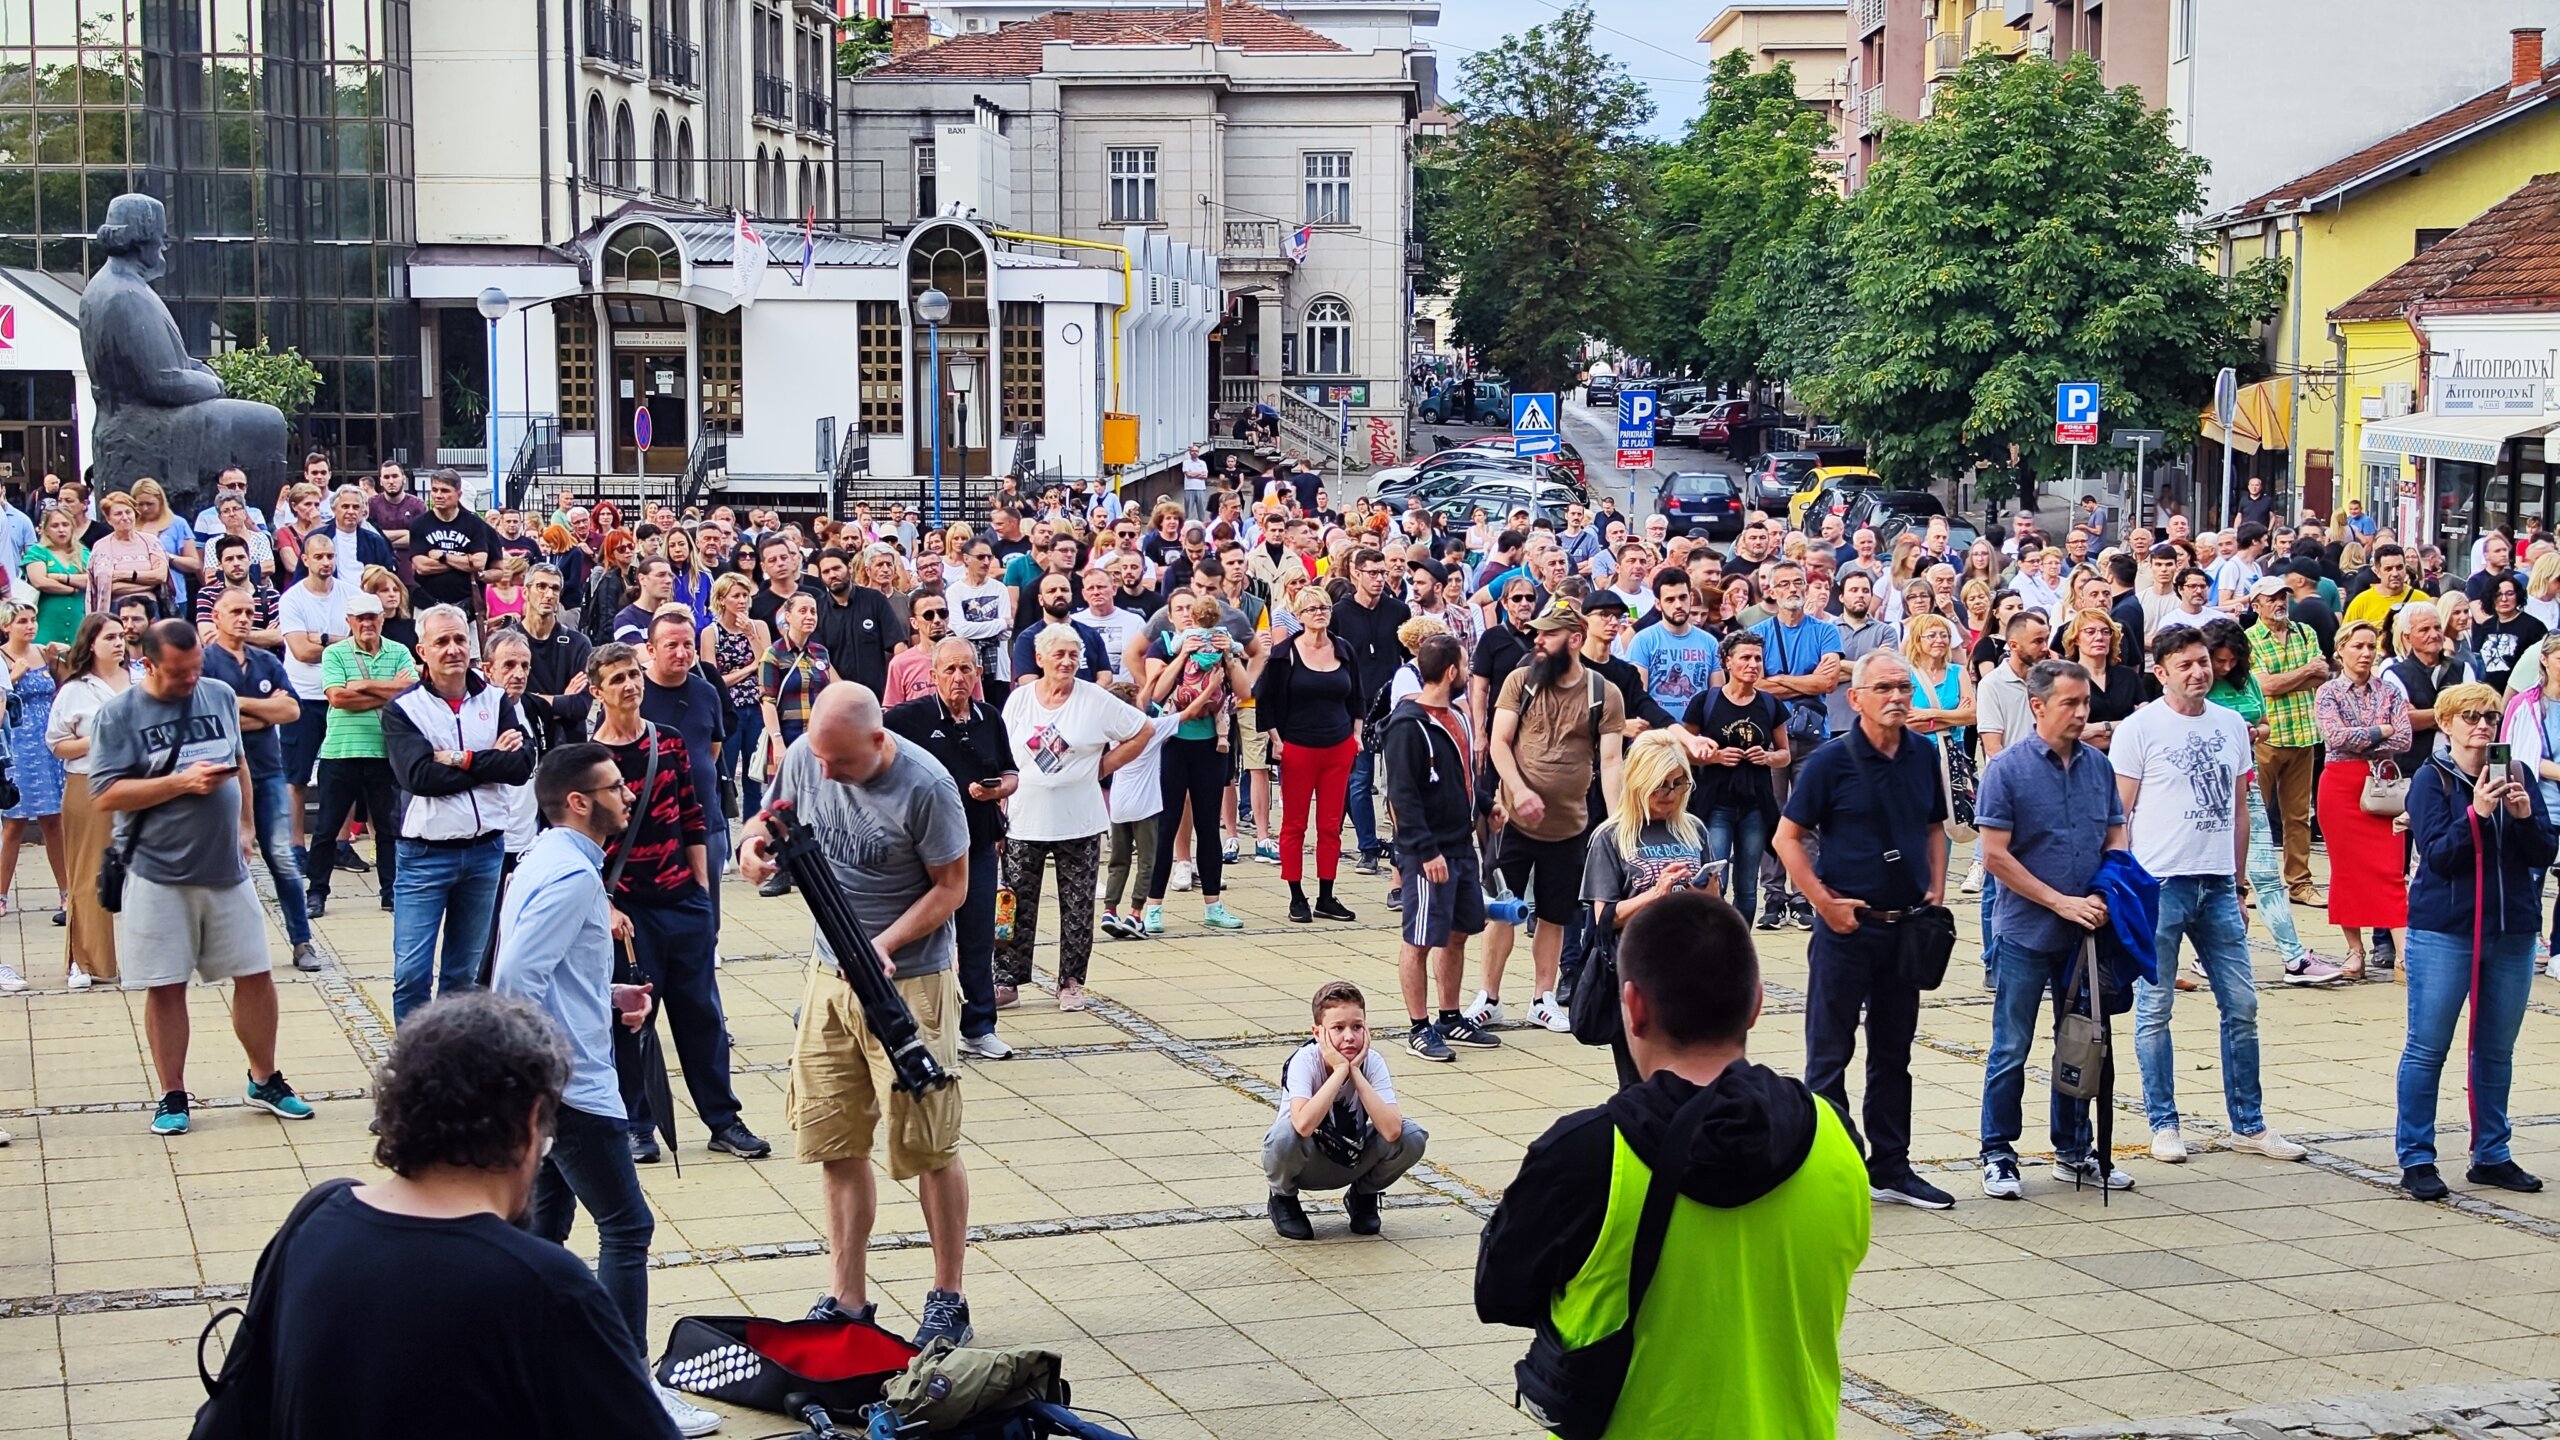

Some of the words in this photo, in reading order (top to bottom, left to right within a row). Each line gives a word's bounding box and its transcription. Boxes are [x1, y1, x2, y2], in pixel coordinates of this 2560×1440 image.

[947, 127, 966, 135] BAXI
[2067, 389, 2091, 418] P
[1632, 396, 1652, 425] P
[1646, 420, 1653, 431] 3
[1619, 430, 1653, 439] PARKIRANJE
[1621, 439, 1630, 448] SE
[425, 529, 471, 548] VIOLENT
[2184, 810, 2205, 820] LIVE
[2205, 808, 2216, 818] TO
[2195, 820, 2217, 832] RIDE
[2220, 819, 2230, 828] TO
